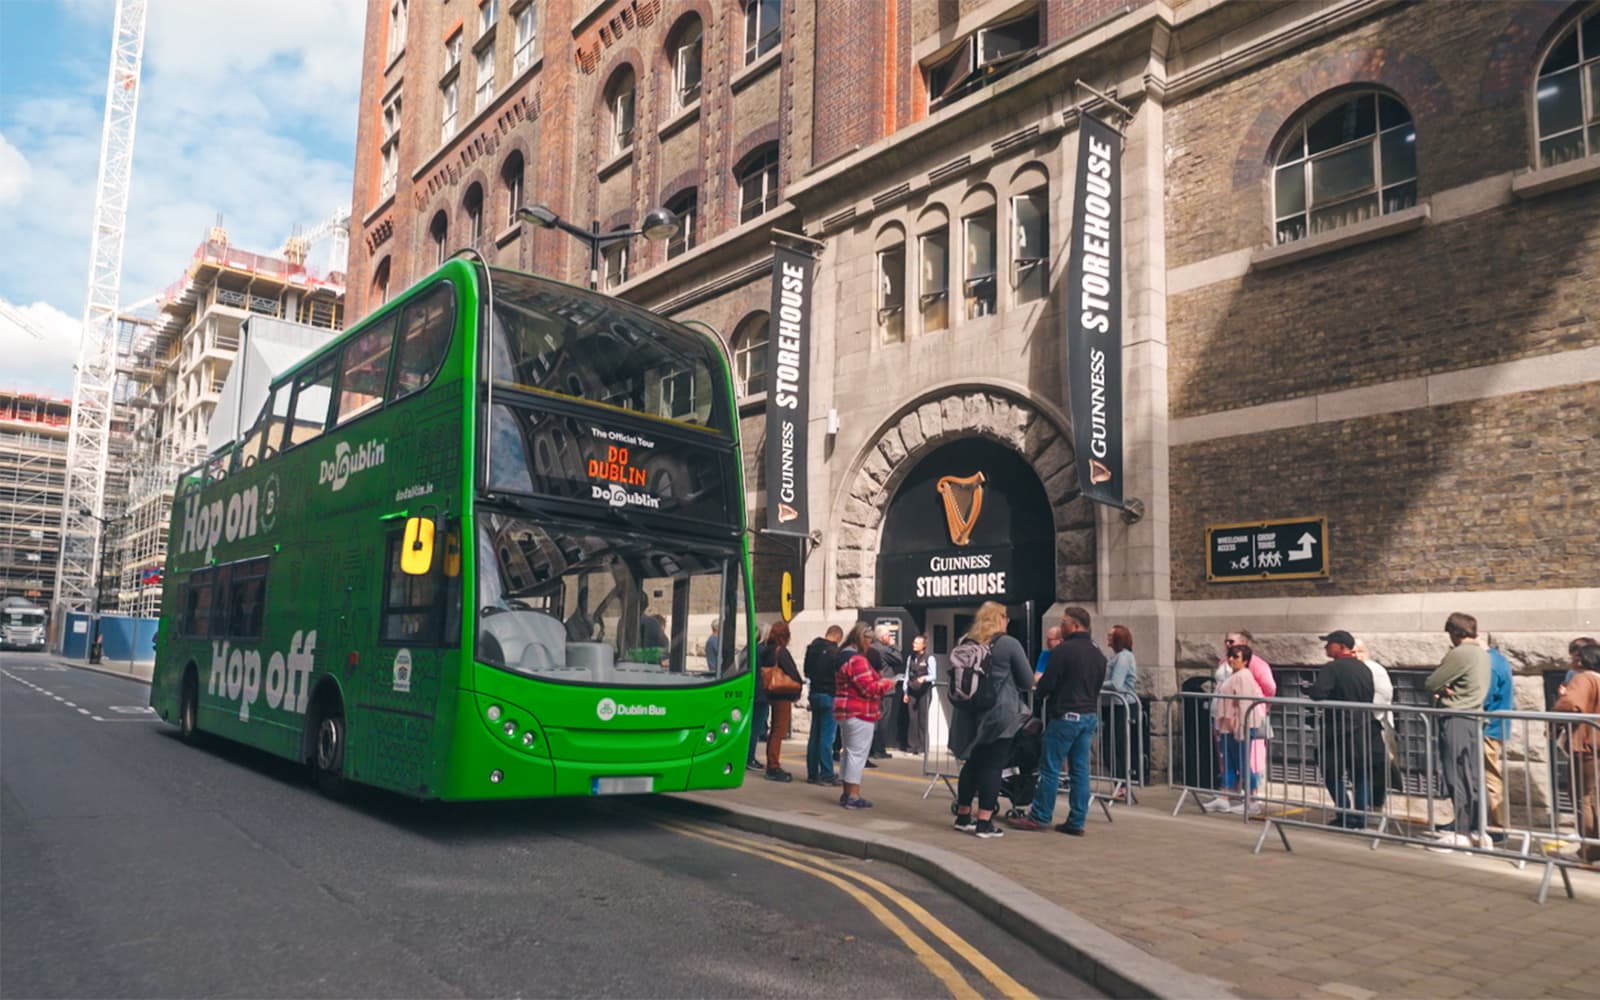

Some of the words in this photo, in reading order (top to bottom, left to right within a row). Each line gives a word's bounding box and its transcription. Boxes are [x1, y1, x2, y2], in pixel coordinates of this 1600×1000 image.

[1081, 136, 1111, 333] STOREHOUSE
[776, 262, 804, 409] STOREHOUSE
[1090, 347, 1107, 458] GUINNESS
[591, 427, 607, 438] The
[608, 431, 637, 445] Official
[637, 437, 655, 449] Tour
[608, 445, 629, 465] DO
[318, 438, 385, 492] DoDublin
[588, 458, 646, 487] DUBLIN
[781, 420, 794, 503] GUINNESS
[591, 483, 660, 509] DoDublin
[181, 494, 223, 564] Hop
[225, 485, 259, 543] on
[930, 554, 992, 571] GUINNESS
[916, 572, 1005, 597] STOREHOUSE
[208, 640, 261, 723] Hop
[265, 629, 317, 714] off
[617, 703, 647, 715] Dublin
[648, 704, 666, 715] Bus
